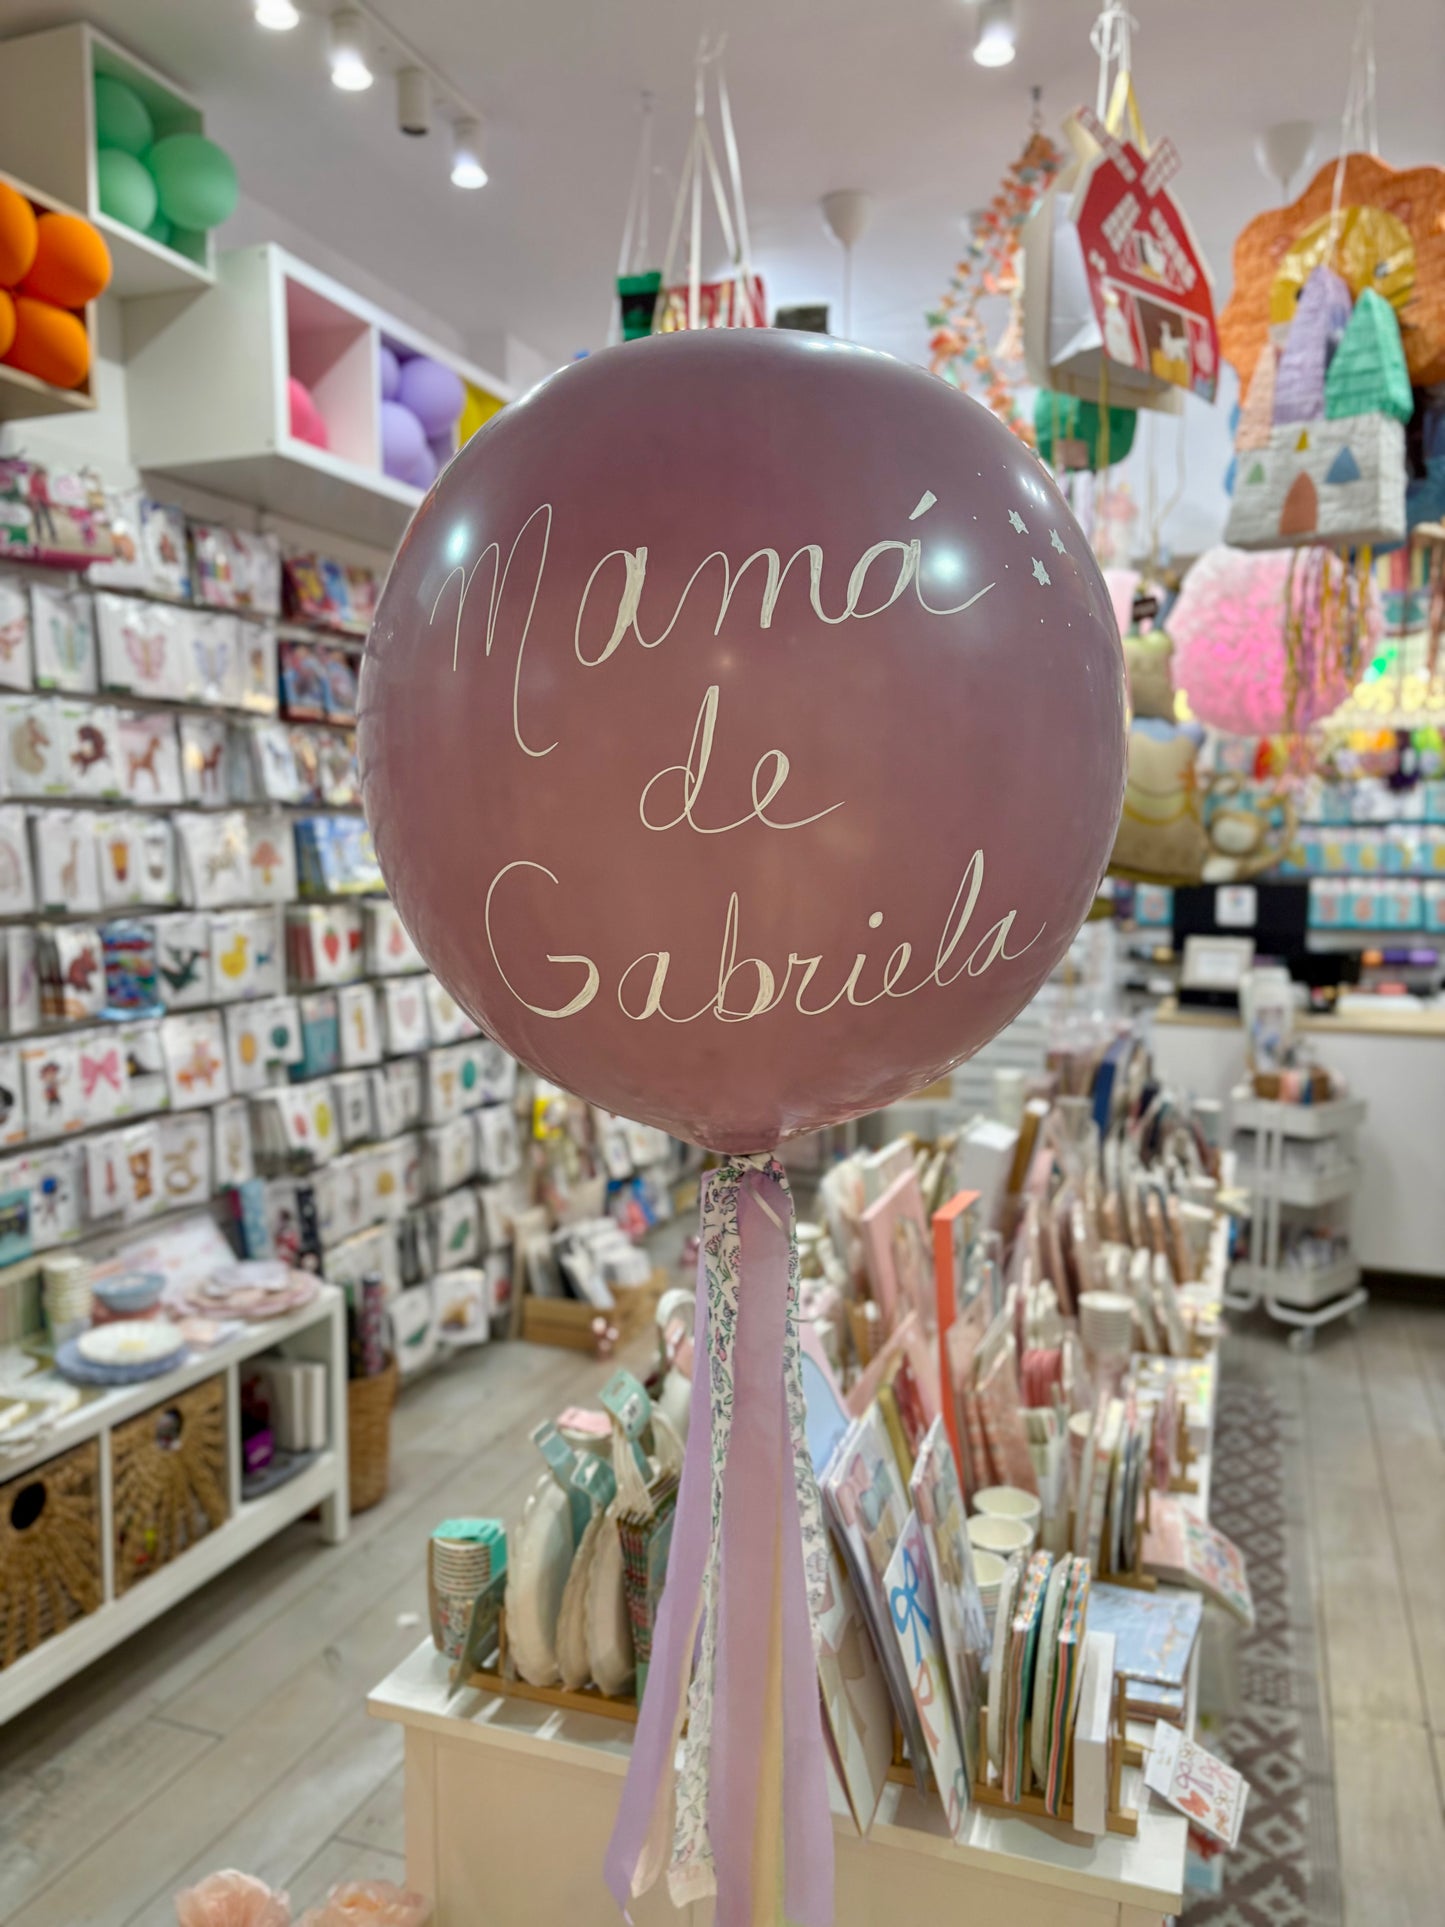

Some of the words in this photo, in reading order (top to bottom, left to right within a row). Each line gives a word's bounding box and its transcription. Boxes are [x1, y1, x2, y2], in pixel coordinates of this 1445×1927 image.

[430, 490, 996, 756] Mamá
[640, 685, 845, 832] de
[485, 850, 1047, 1023] Gabriela
